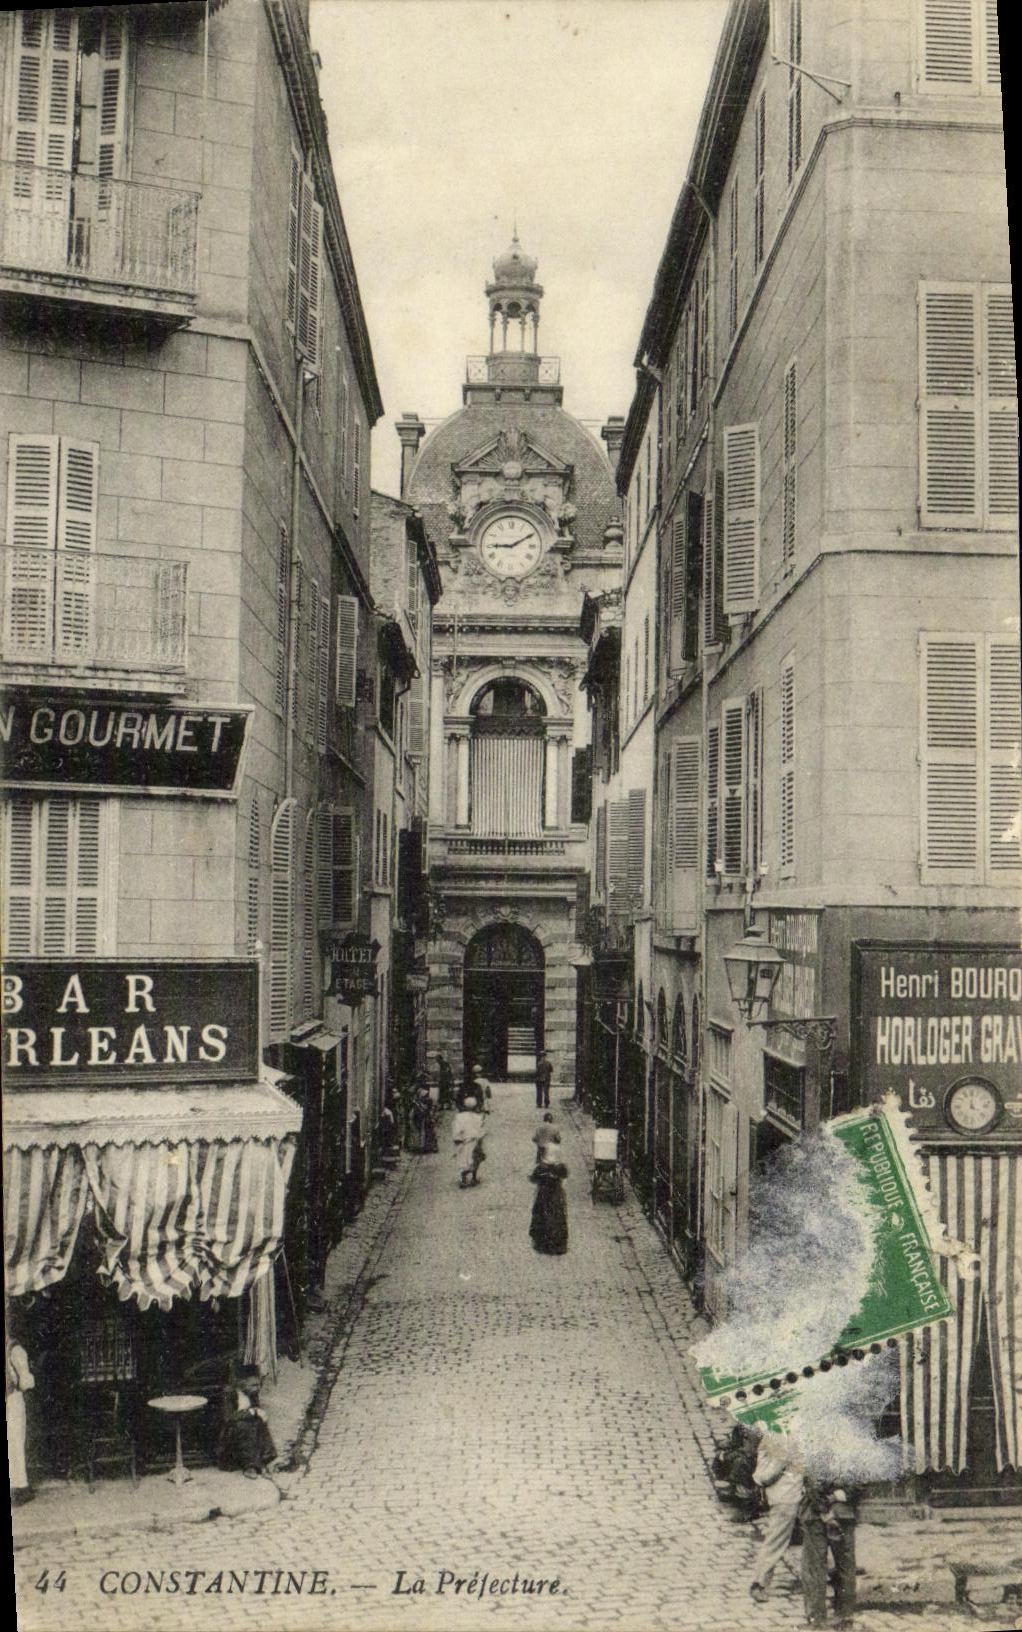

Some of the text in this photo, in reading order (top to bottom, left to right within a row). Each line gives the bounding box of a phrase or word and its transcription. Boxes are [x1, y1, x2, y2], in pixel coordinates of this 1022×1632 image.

[29, 707, 231, 753] GOURMET
[1, 973, 156, 1014] BAR
[881, 966, 939, 999] Henri
[7, 1024, 228, 1067] RLEANS
[876, 1015, 973, 1066] HORLOGER
